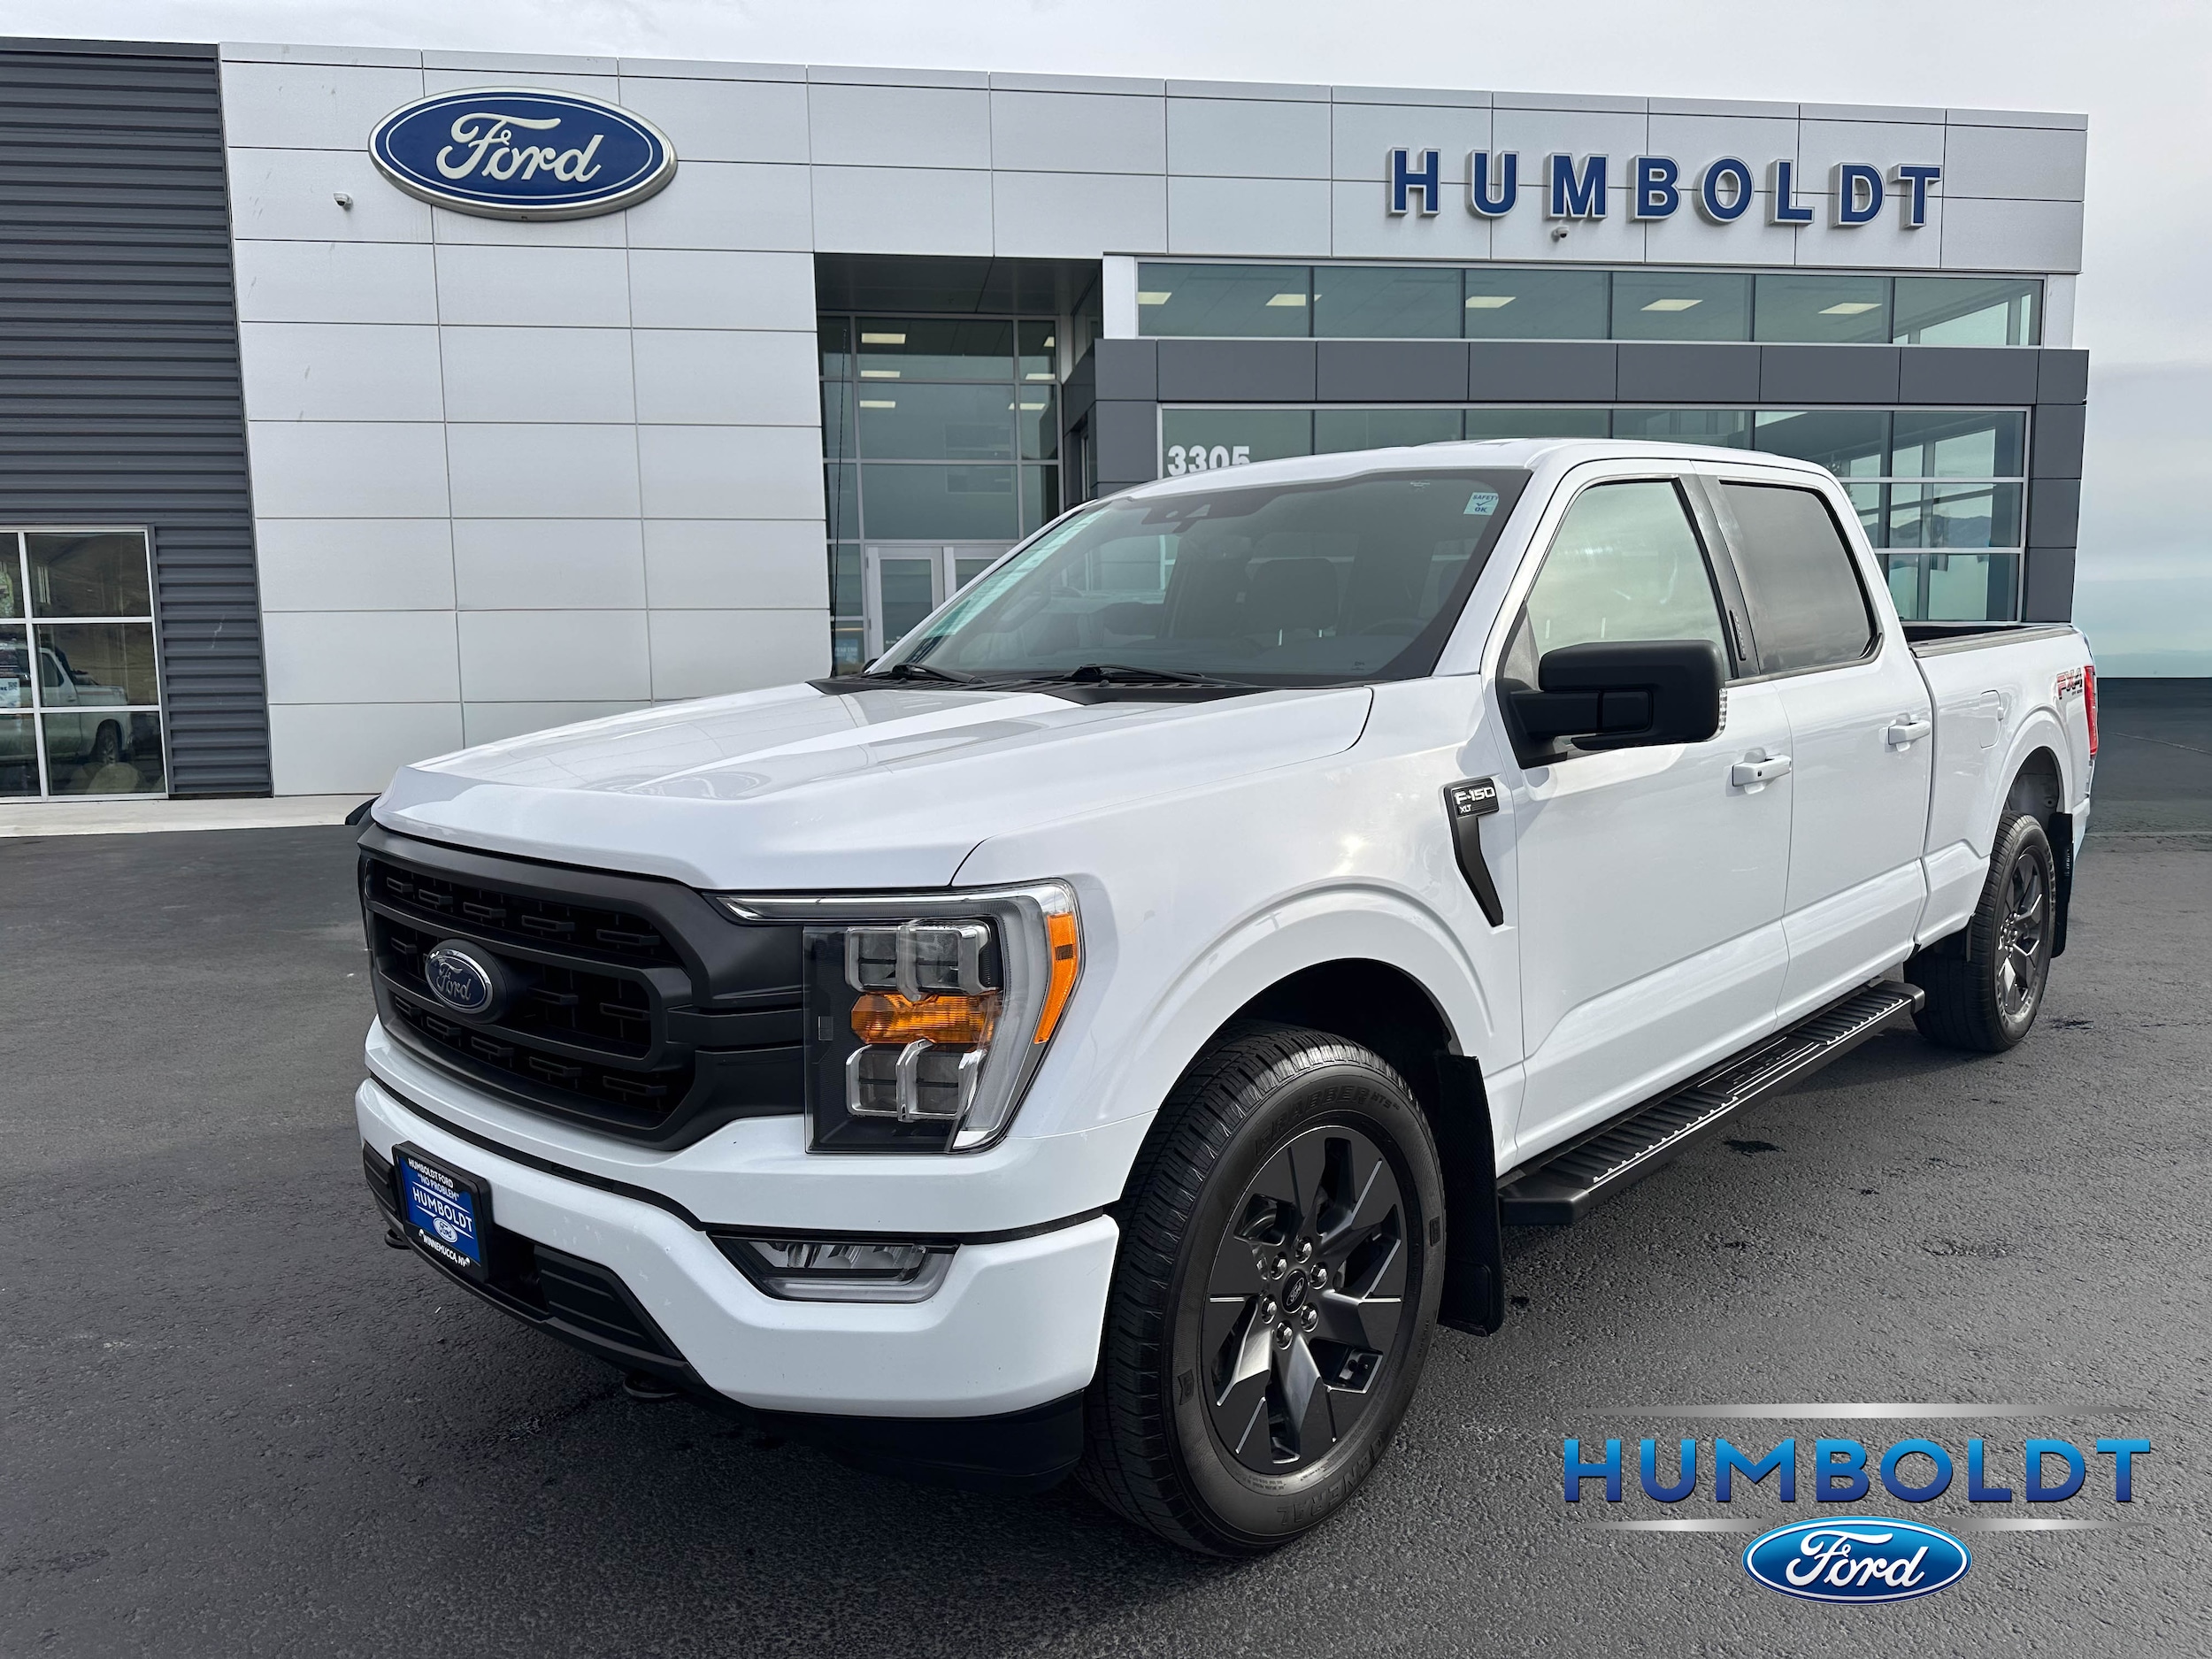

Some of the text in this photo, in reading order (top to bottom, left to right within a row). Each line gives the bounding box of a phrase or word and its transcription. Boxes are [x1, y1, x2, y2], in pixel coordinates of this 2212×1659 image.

[436, 112, 604, 182] Ford
[1387, 147, 1943, 228] HUMBOLDT
[1167, 445, 1250, 476] 3305
[1454, 787, 1495, 804] F-150
[1460, 804, 1471, 813] XLT
[436, 962, 472, 1001] Ford
[408, 1158, 453, 1188] HUMBOLDT FORD
[412, 1187, 472, 1232] HUMBOLDT
[438, 1222, 453, 1238] Ford
[423, 1233, 458, 1264] WINNEMUCCA,
